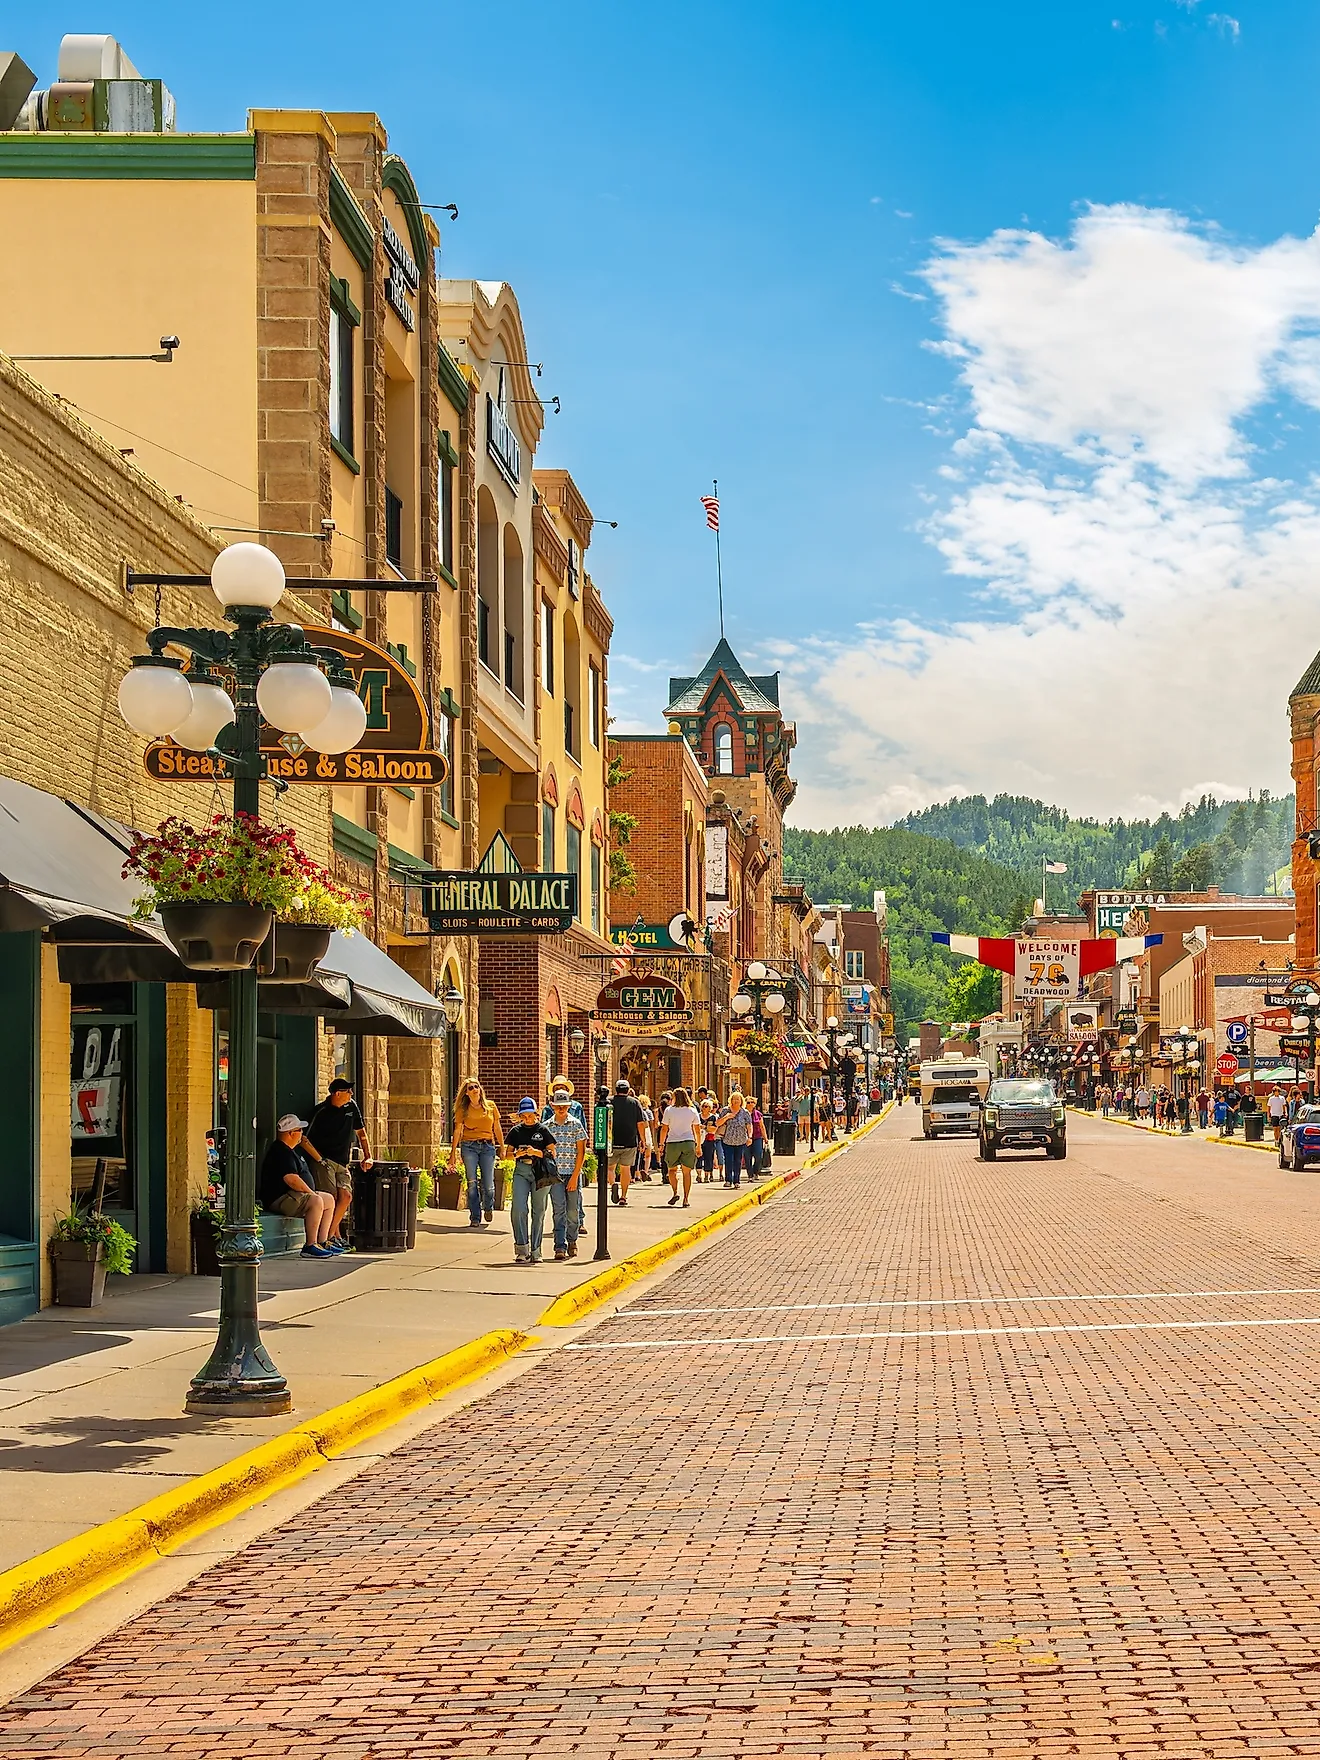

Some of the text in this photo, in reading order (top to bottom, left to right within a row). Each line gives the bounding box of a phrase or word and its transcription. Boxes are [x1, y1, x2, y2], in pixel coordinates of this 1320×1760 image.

[315, 754, 337, 777] &
[344, 754, 433, 779] Saloon
[431, 880, 569, 911] MINERAL PALACE
[1099, 894, 1166, 904] BODEGA
[442, 918, 468, 927] SLOTS
[478, 917, 521, 927] ROULETTE
[531, 917, 560, 927] CARDS
[618, 931, 658, 944] HOTEL
[1018, 943, 1077, 957] WELCOME
[1029, 962, 1065, 987] 76
[1246, 976, 1282, 984] diamond
[1288, 979, 1318, 991] OYSTER BAY
[620, 987, 676, 1009] GEM
[593, 1010, 688, 1020] Steakhouse & Saloon
[1069, 1032, 1097, 1041] SALOON
[1232, 1025, 1244, 1040] P
[1217, 1060, 1238, 1069] STOP
